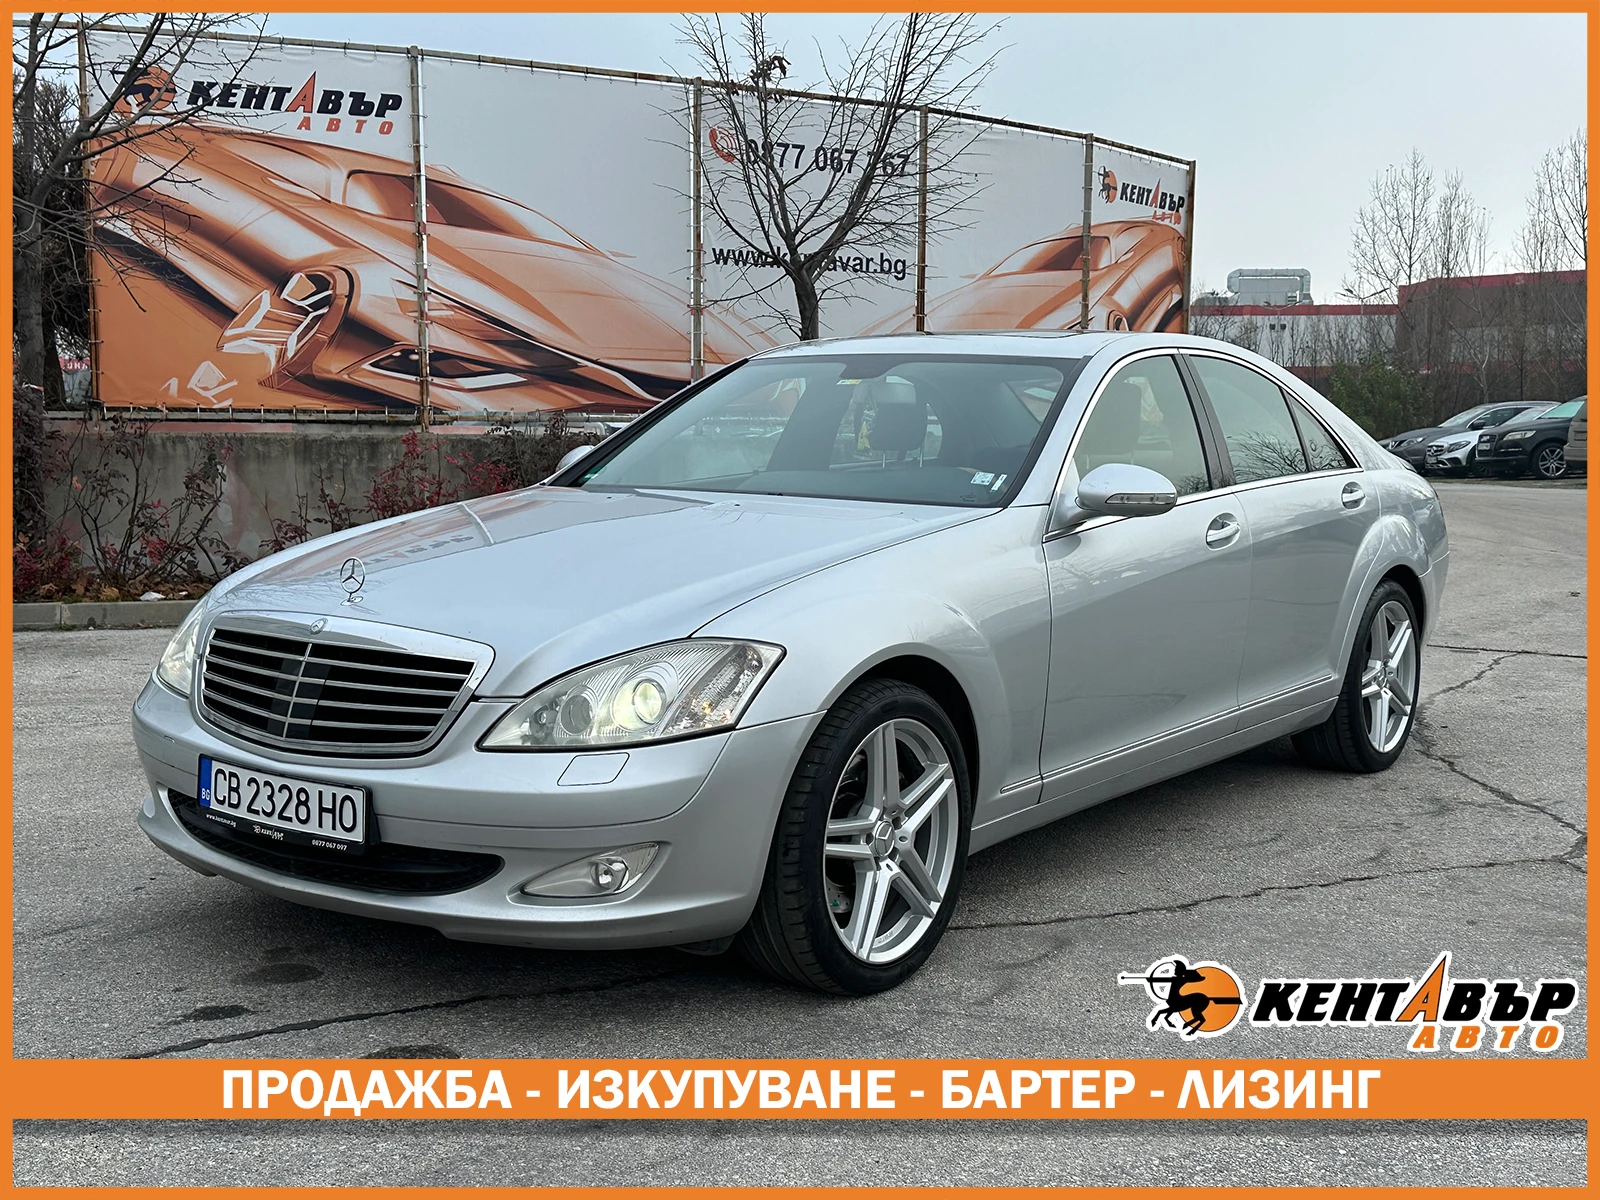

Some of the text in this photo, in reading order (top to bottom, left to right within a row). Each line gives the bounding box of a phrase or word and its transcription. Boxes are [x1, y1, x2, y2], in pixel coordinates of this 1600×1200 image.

[186, 71, 403, 118] КЕНТАВЪР
[297, 116, 394, 135] АВТО
[867, 150, 911, 176] 67
[1119, 178, 1185, 212] КЕНТАВЪР
[201, 787, 211, 801] BG
[214, 768, 241, 809] CB
[246, 777, 311, 825] 2328
